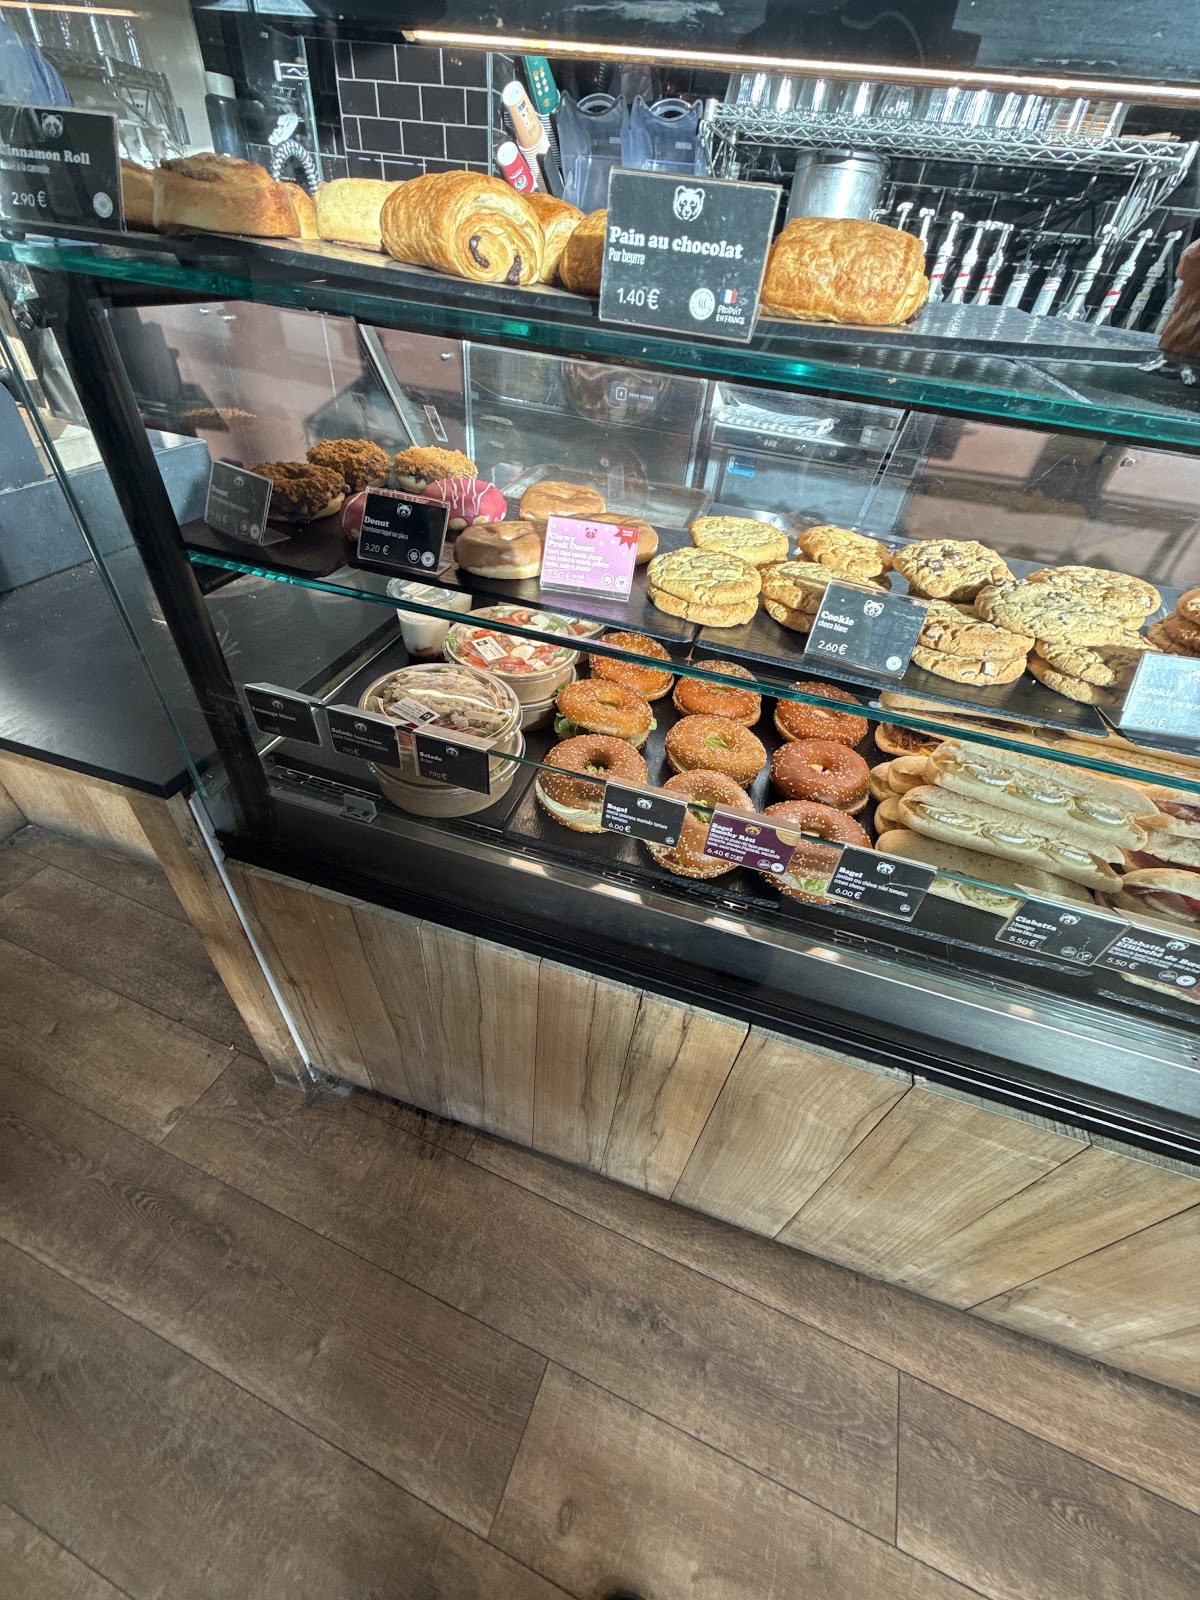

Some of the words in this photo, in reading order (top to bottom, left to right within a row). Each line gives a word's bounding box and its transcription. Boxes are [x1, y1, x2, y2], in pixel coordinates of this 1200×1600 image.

[63, 150, 90, 165] Roll
[609, 226, 645, 247] Pain
[648, 235, 669, 250] au
[672, 236, 744, 259] chocolat
[609, 247, 622, 262] Pur
[622, 250, 645, 266] beurre
[364, 516, 390, 528] Donut
[549, 532, 576, 543] Glowy
[570, 542, 595, 553] Donut
[821, 611, 854, 626] Cookie
[818, 620, 833, 629] choco
[833, 623, 848, 633] blanc
[1139, 685, 1176, 697] Cookie
[251, 706, 278, 717] Fromage
[331, 727, 353, 738] Salade
[420, 752, 442, 761] Salade
[607, 803, 628, 814] Bagel
[611, 814, 628, 824] tomates
[711, 827, 737, 839] Smoky
[712, 823, 733, 832] Bagel
[838, 867, 863, 878] Bagel
[849, 882, 865, 891] cheese
[862, 880, 877, 889] chèvre
[889, 887, 908, 897] tomates
[1014, 922, 1035, 932] fromages
[1015, 916, 1057, 931] Ciabatta
[1116, 941, 1164, 957] Effiloché
[1122, 937, 1165, 952] Ciabatta
